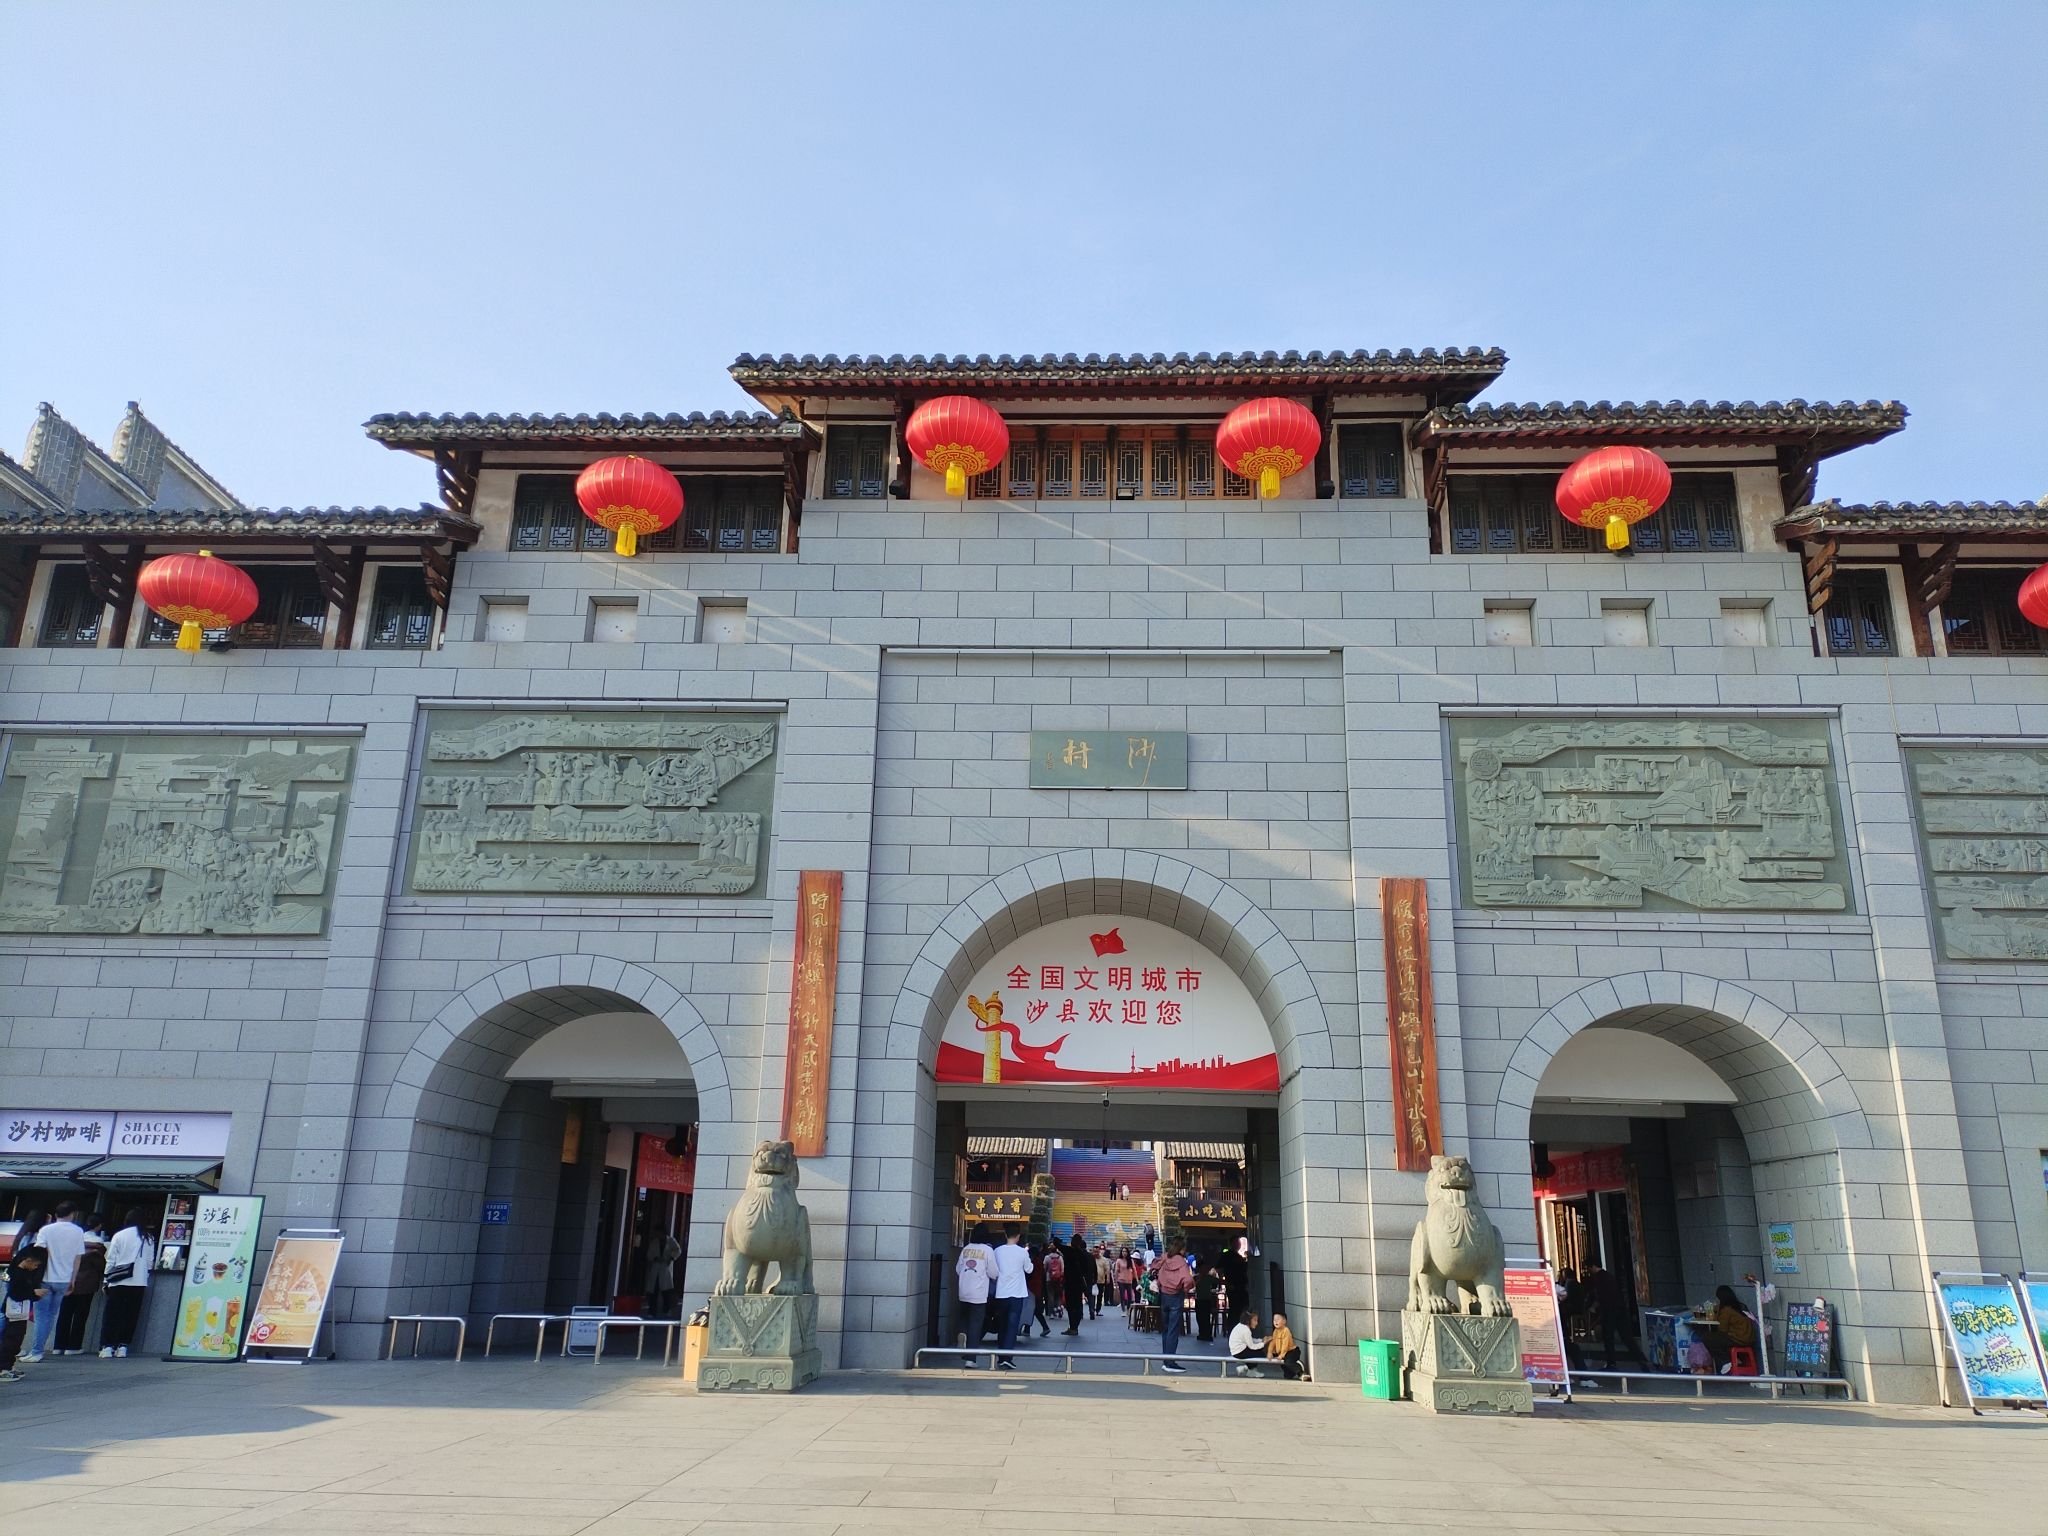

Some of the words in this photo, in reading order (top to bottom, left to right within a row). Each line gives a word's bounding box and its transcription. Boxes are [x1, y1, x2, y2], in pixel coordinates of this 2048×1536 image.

[1006, 966, 1203, 993] 全国文明城市
[1026, 999, 1183, 1026] 沙县欢迎您
[8, 1120, 102, 1143] 沙村咖啡
[124, 1122, 182, 1133] SHACUN
[121, 1133, 180, 1146] COFFEE
